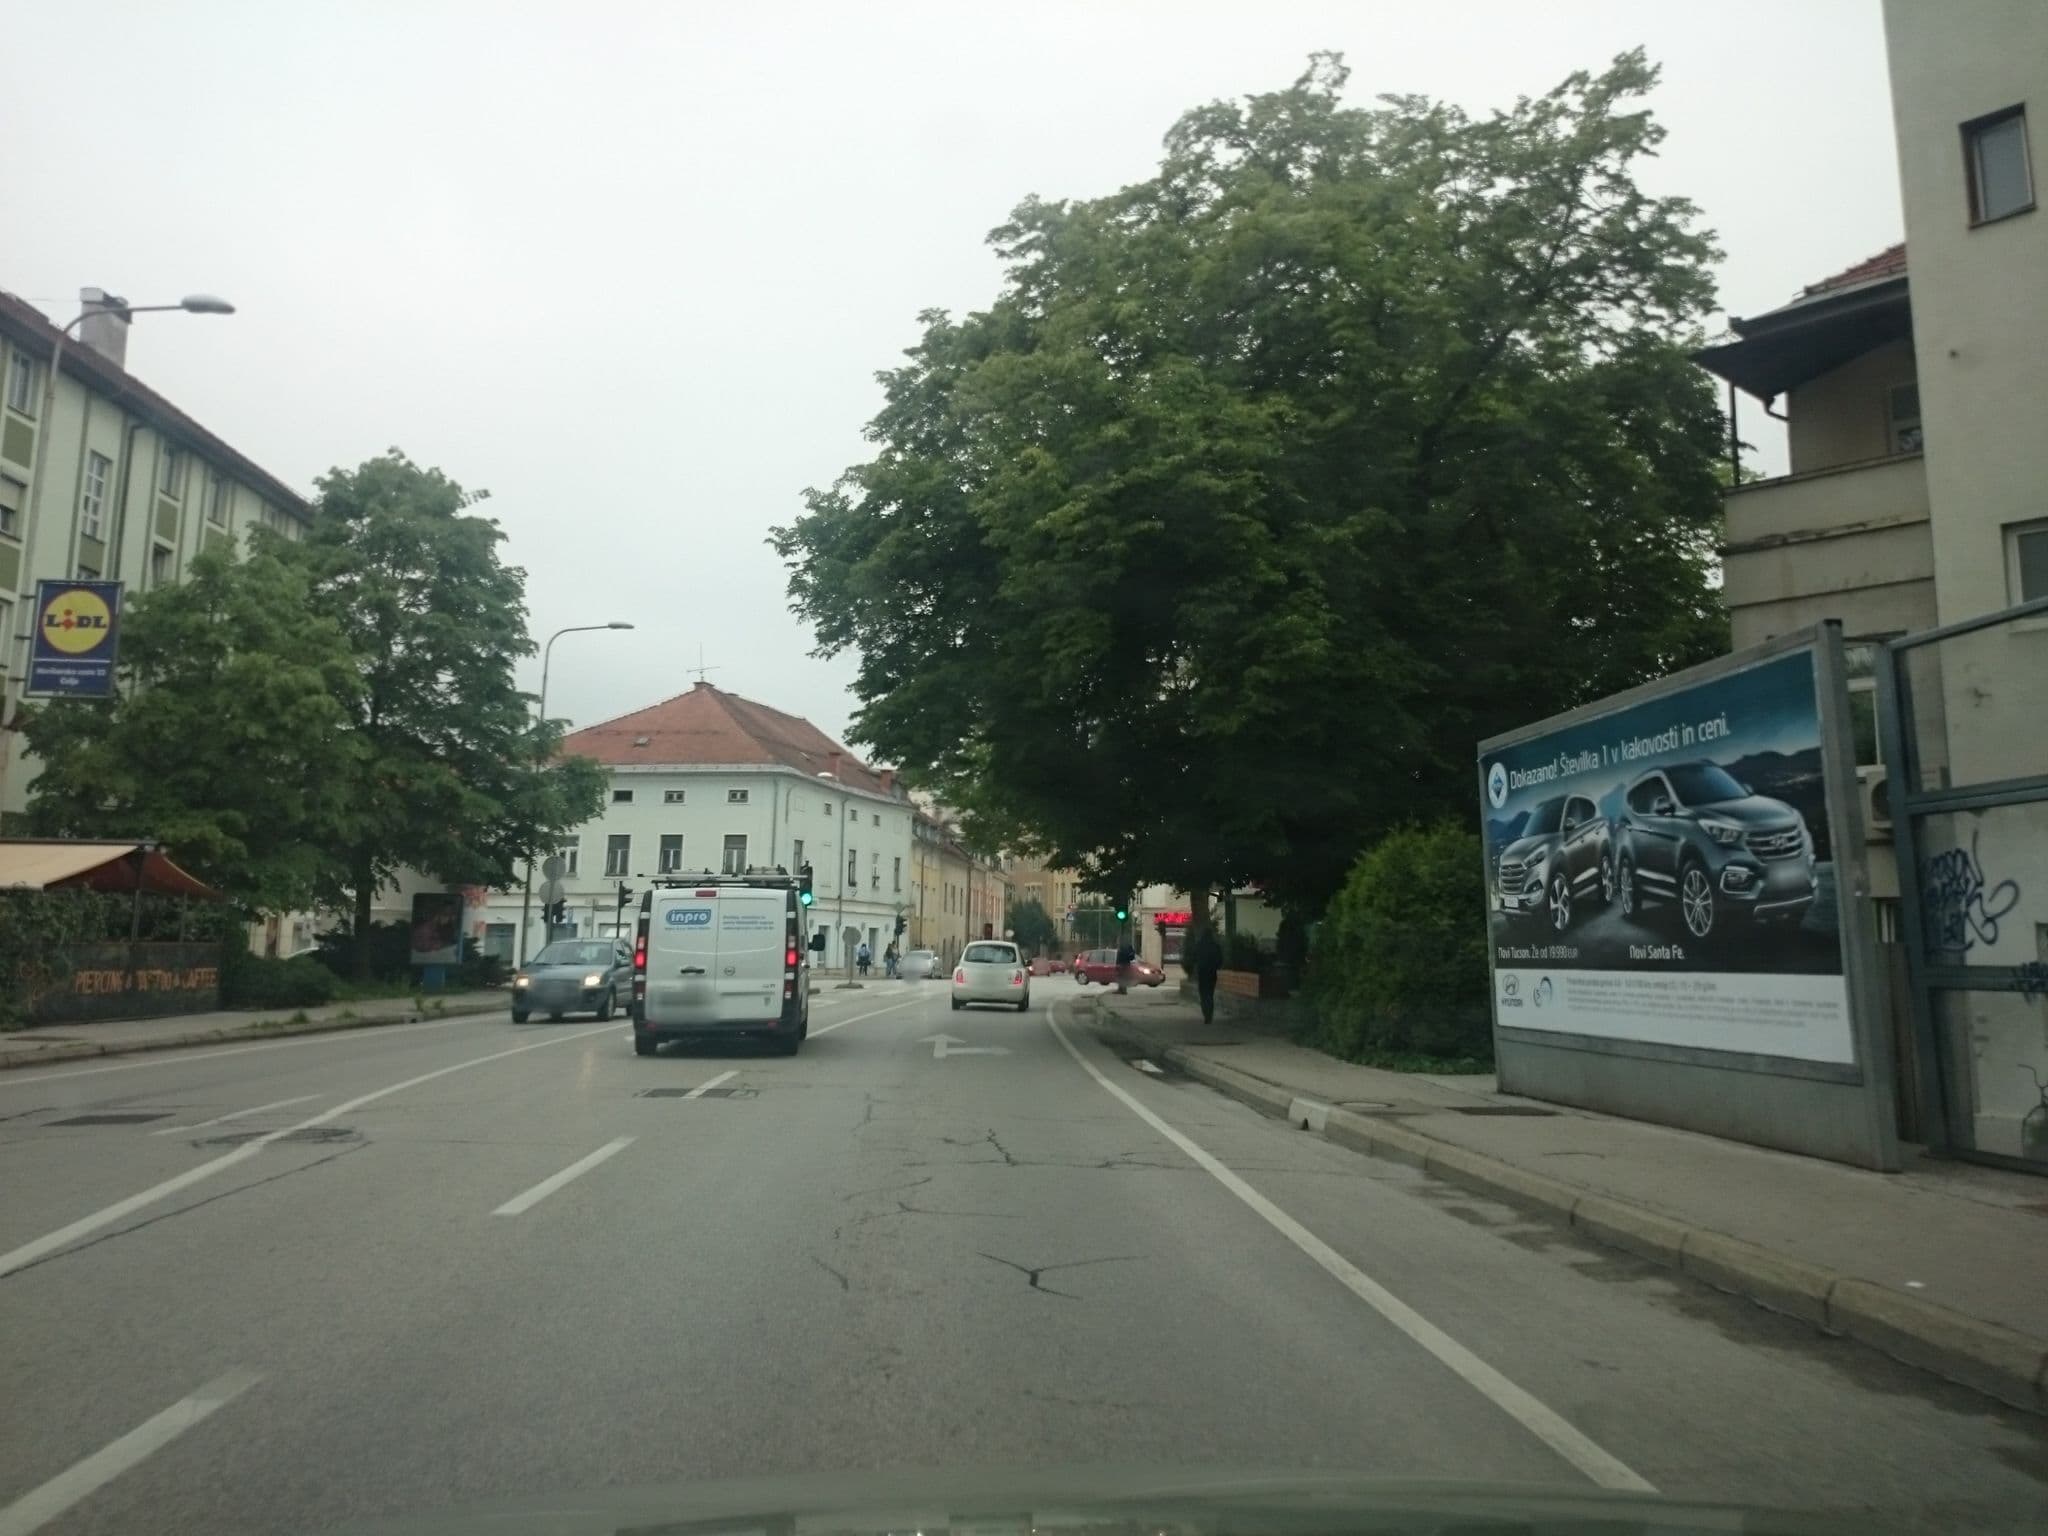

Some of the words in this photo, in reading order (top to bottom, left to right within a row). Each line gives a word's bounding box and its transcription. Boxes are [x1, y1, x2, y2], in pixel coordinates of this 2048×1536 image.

[1510, 758, 1557, 789] Dokazano!
[1560, 751, 1599, 777] Številka
[1602, 745, 1608, 767] 1
[1611, 747, 1619, 764] v
[1621, 725, 1679, 761] kakovosti
[1682, 722, 1695, 746] in
[1698, 711, 1731, 742] ceni.
[671, 911, 707, 923] inpro
[1629, 944, 1647, 959] Novi
[1647, 944, 1671, 960] Santa
